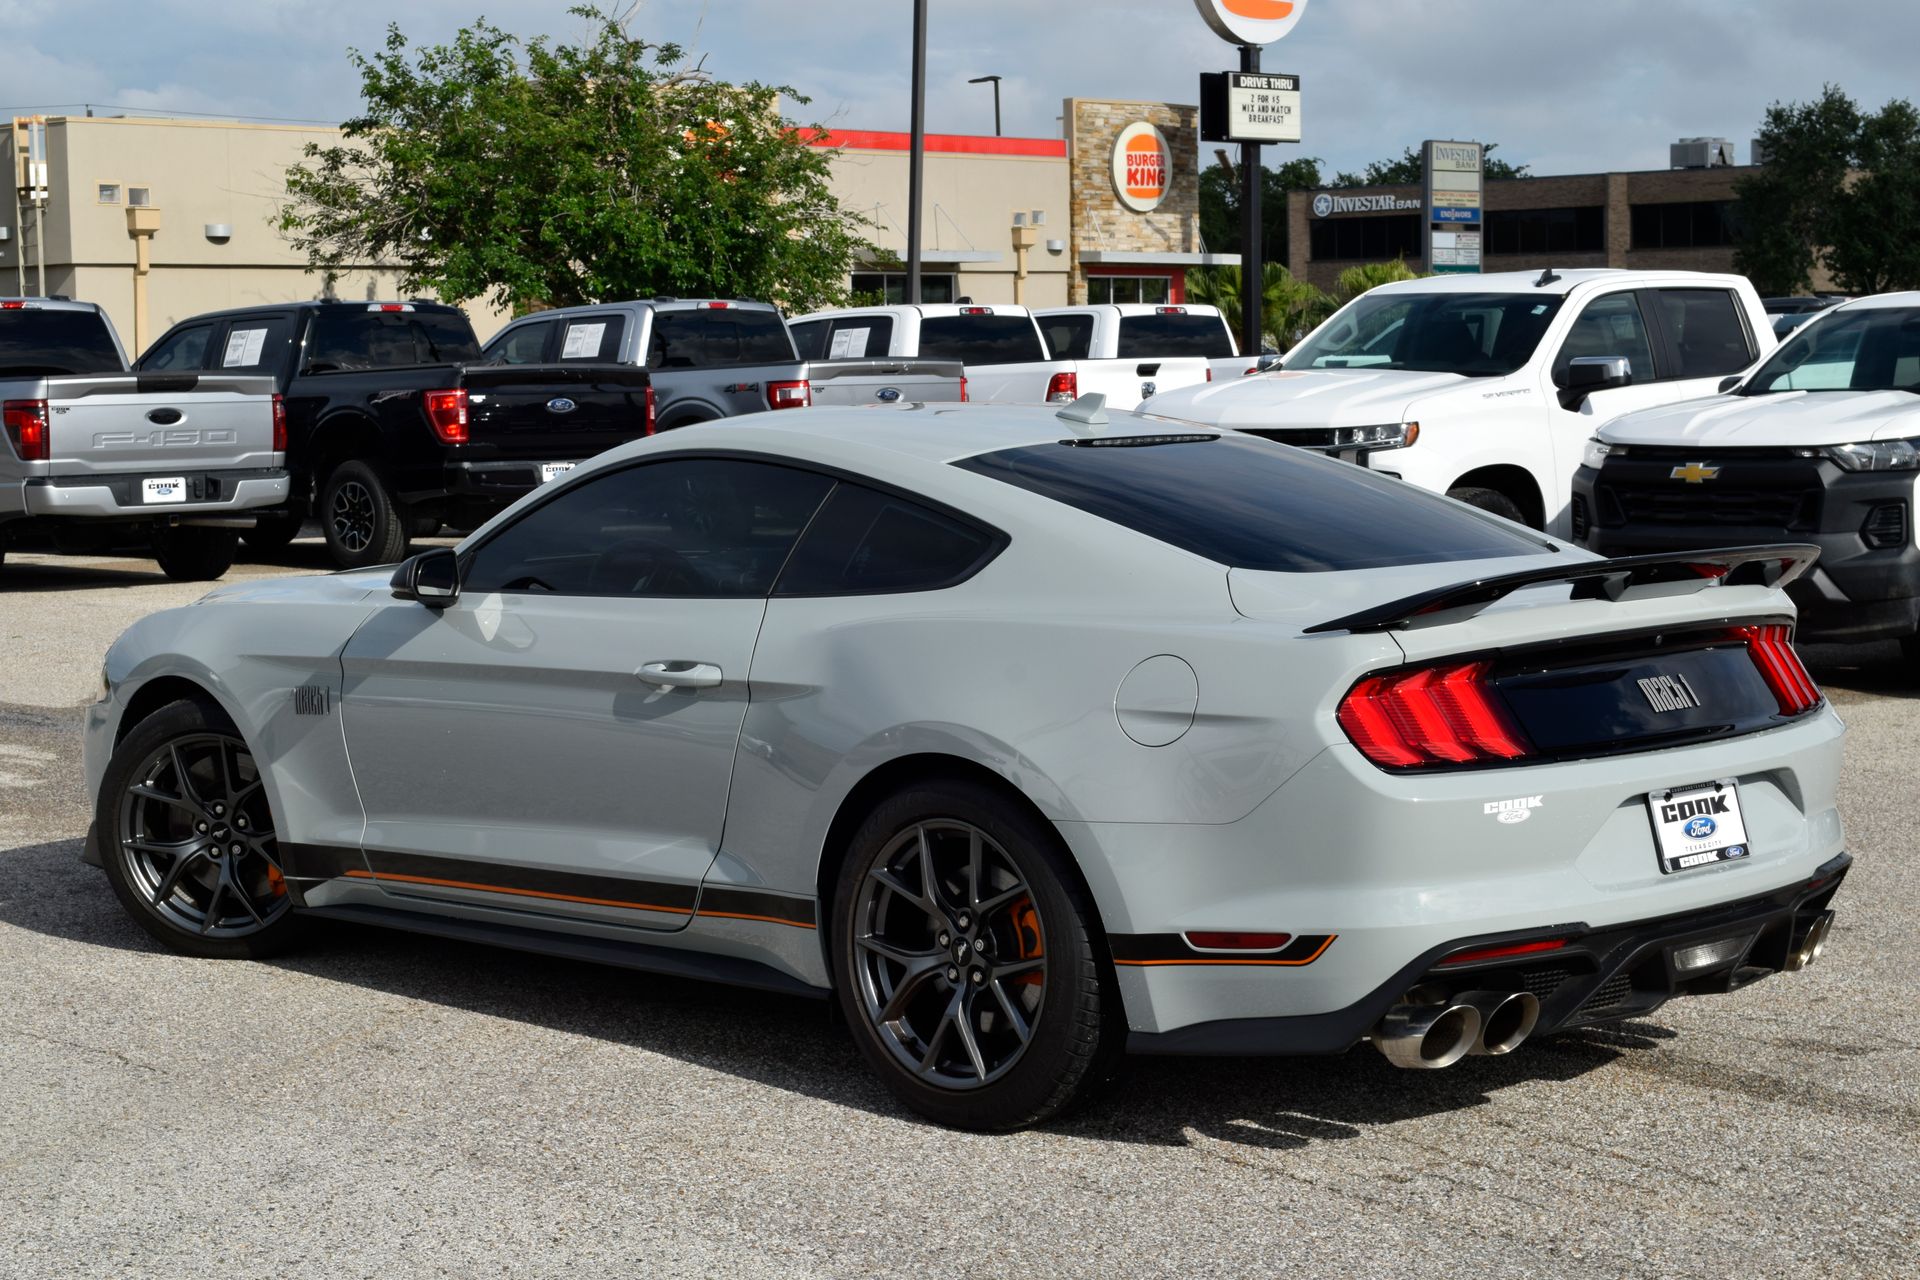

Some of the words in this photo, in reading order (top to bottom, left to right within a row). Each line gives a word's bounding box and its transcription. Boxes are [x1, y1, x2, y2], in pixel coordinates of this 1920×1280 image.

[1240, 76, 1268, 88] DRIVE
[1270, 78, 1293, 90] THRU
[1250, 94, 1255, 103] 2
[1257, 94, 1269, 103] FOR
[1242, 104, 1255, 113] MIX
[1257, 105, 1269, 113] AND
[1271, 105, 1292, 115] MATCH
[1248, 114, 1284, 124] BREAKFAST
[1126, 153, 1165, 167] BURGER
[1435, 146, 1477, 161] INVESTAR
[1455, 161, 1477, 169] BANK
[1126, 168, 1166, 186] KING
[1333, 195, 1395, 213] INVESTAR
[1396, 199, 1421, 209] BAN
[92, 429, 237, 448] F-150
[148, 482, 180, 490] COOK
[1484, 795, 1543, 815] COOK
[1661, 794, 1730, 824] COOK
[1690, 819, 1713, 837] Ford
[1685, 844, 1707, 853] TEXAS
[1708, 840, 1722, 848] CITY
[1679, 850, 1720, 868] COOK
